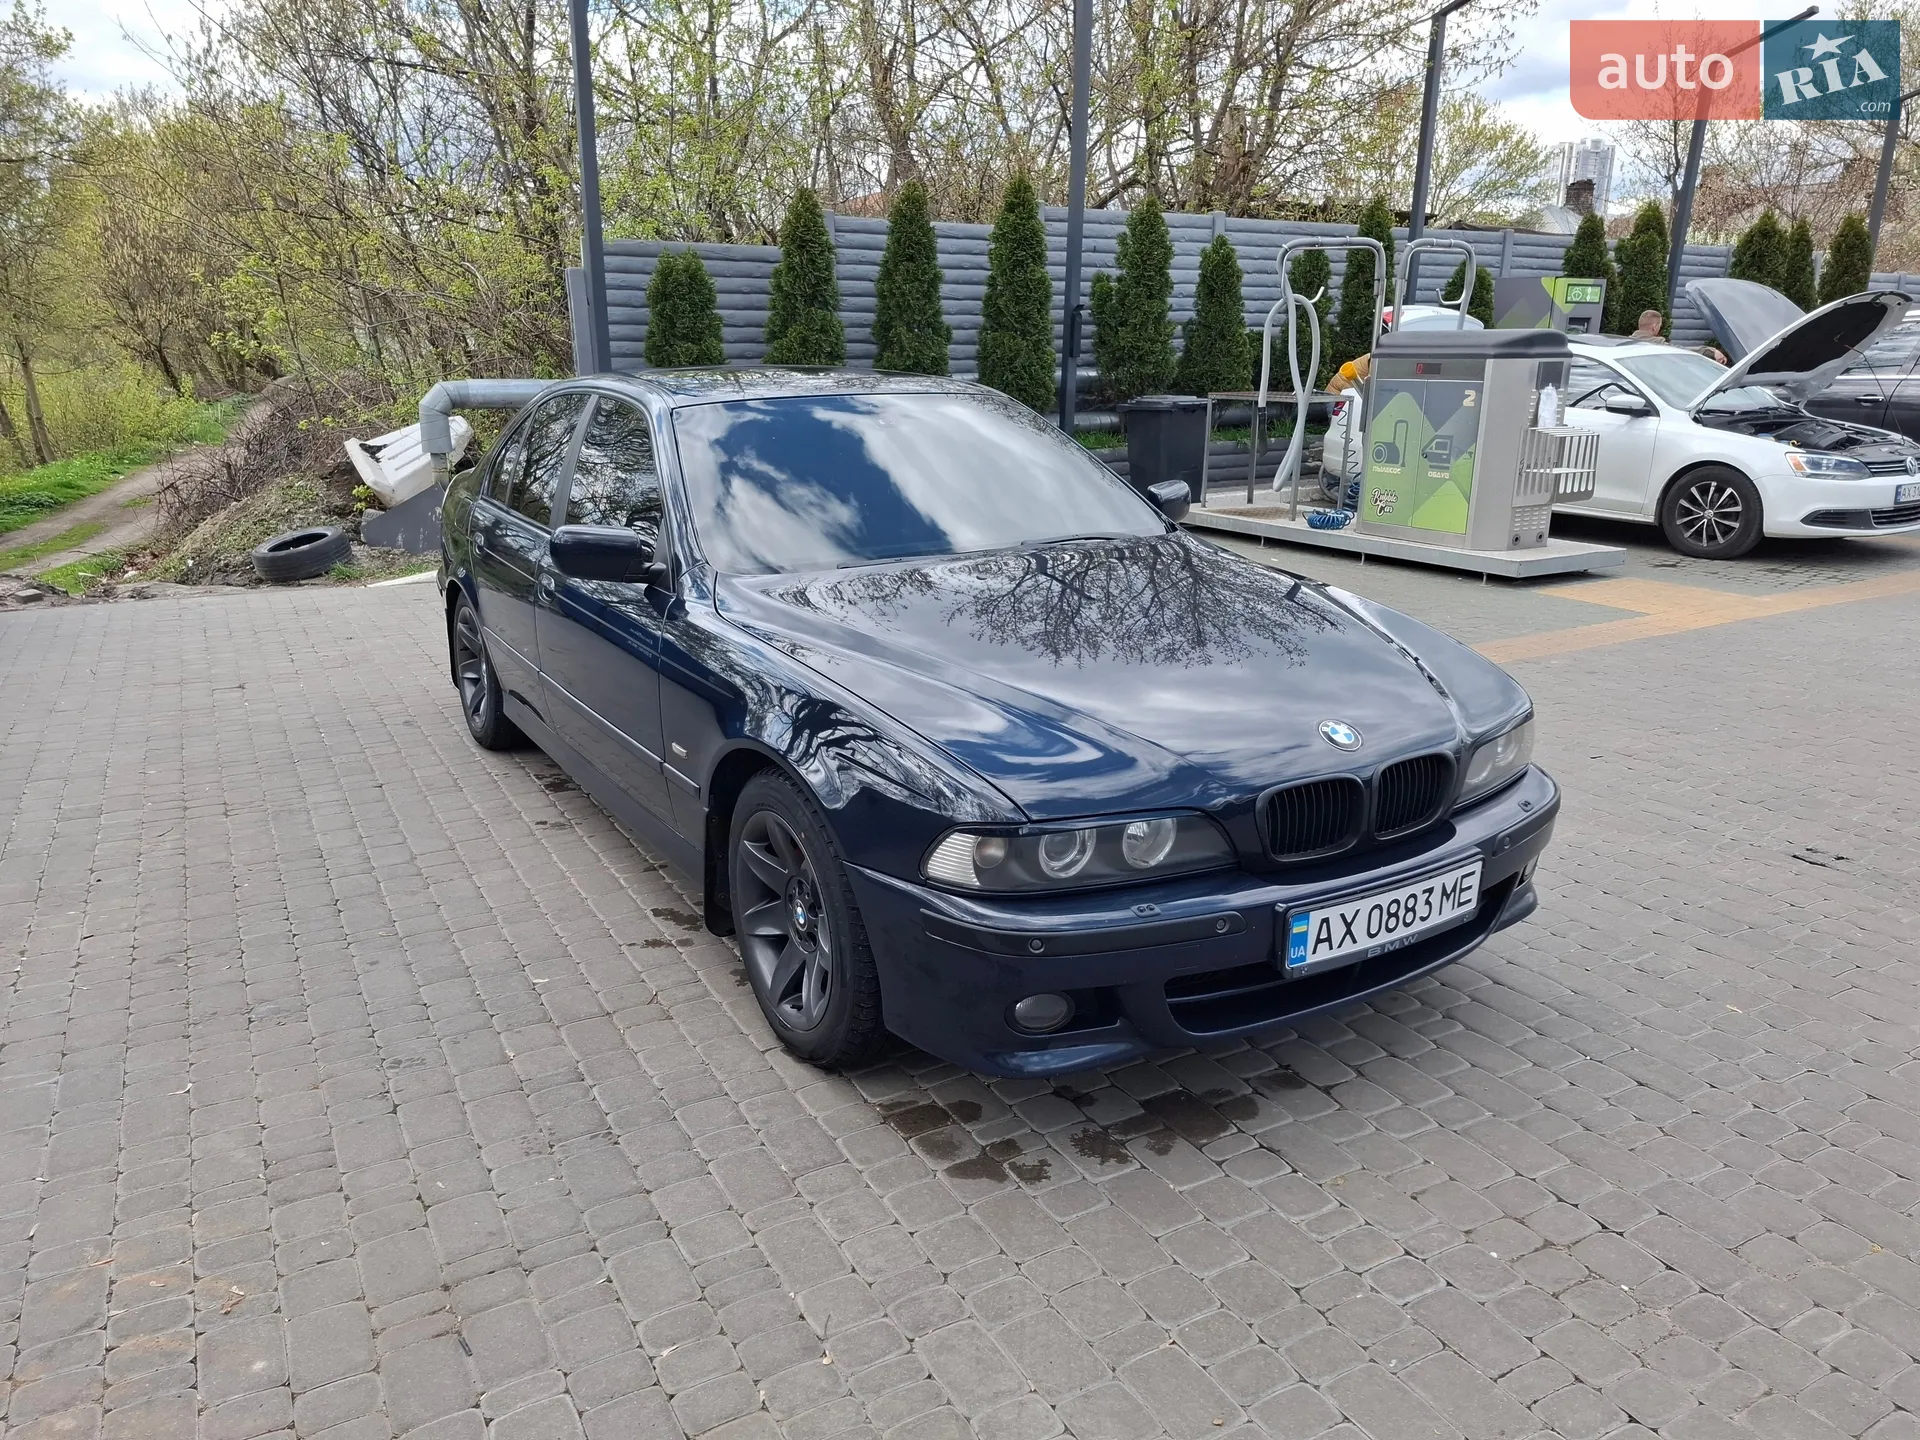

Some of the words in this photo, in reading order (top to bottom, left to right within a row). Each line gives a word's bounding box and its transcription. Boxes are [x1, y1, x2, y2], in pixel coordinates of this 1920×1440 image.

[1462, 390, 1476, 407] 2
[1427, 471, 1450, 479] ОБДУВ
[1311, 908, 1361, 955] AX
[1366, 886, 1435, 939] 0883
[1439, 869, 1477, 916] ME
[1290, 945, 1306, 959] UA
[1367, 933, 1418, 958] BMW
